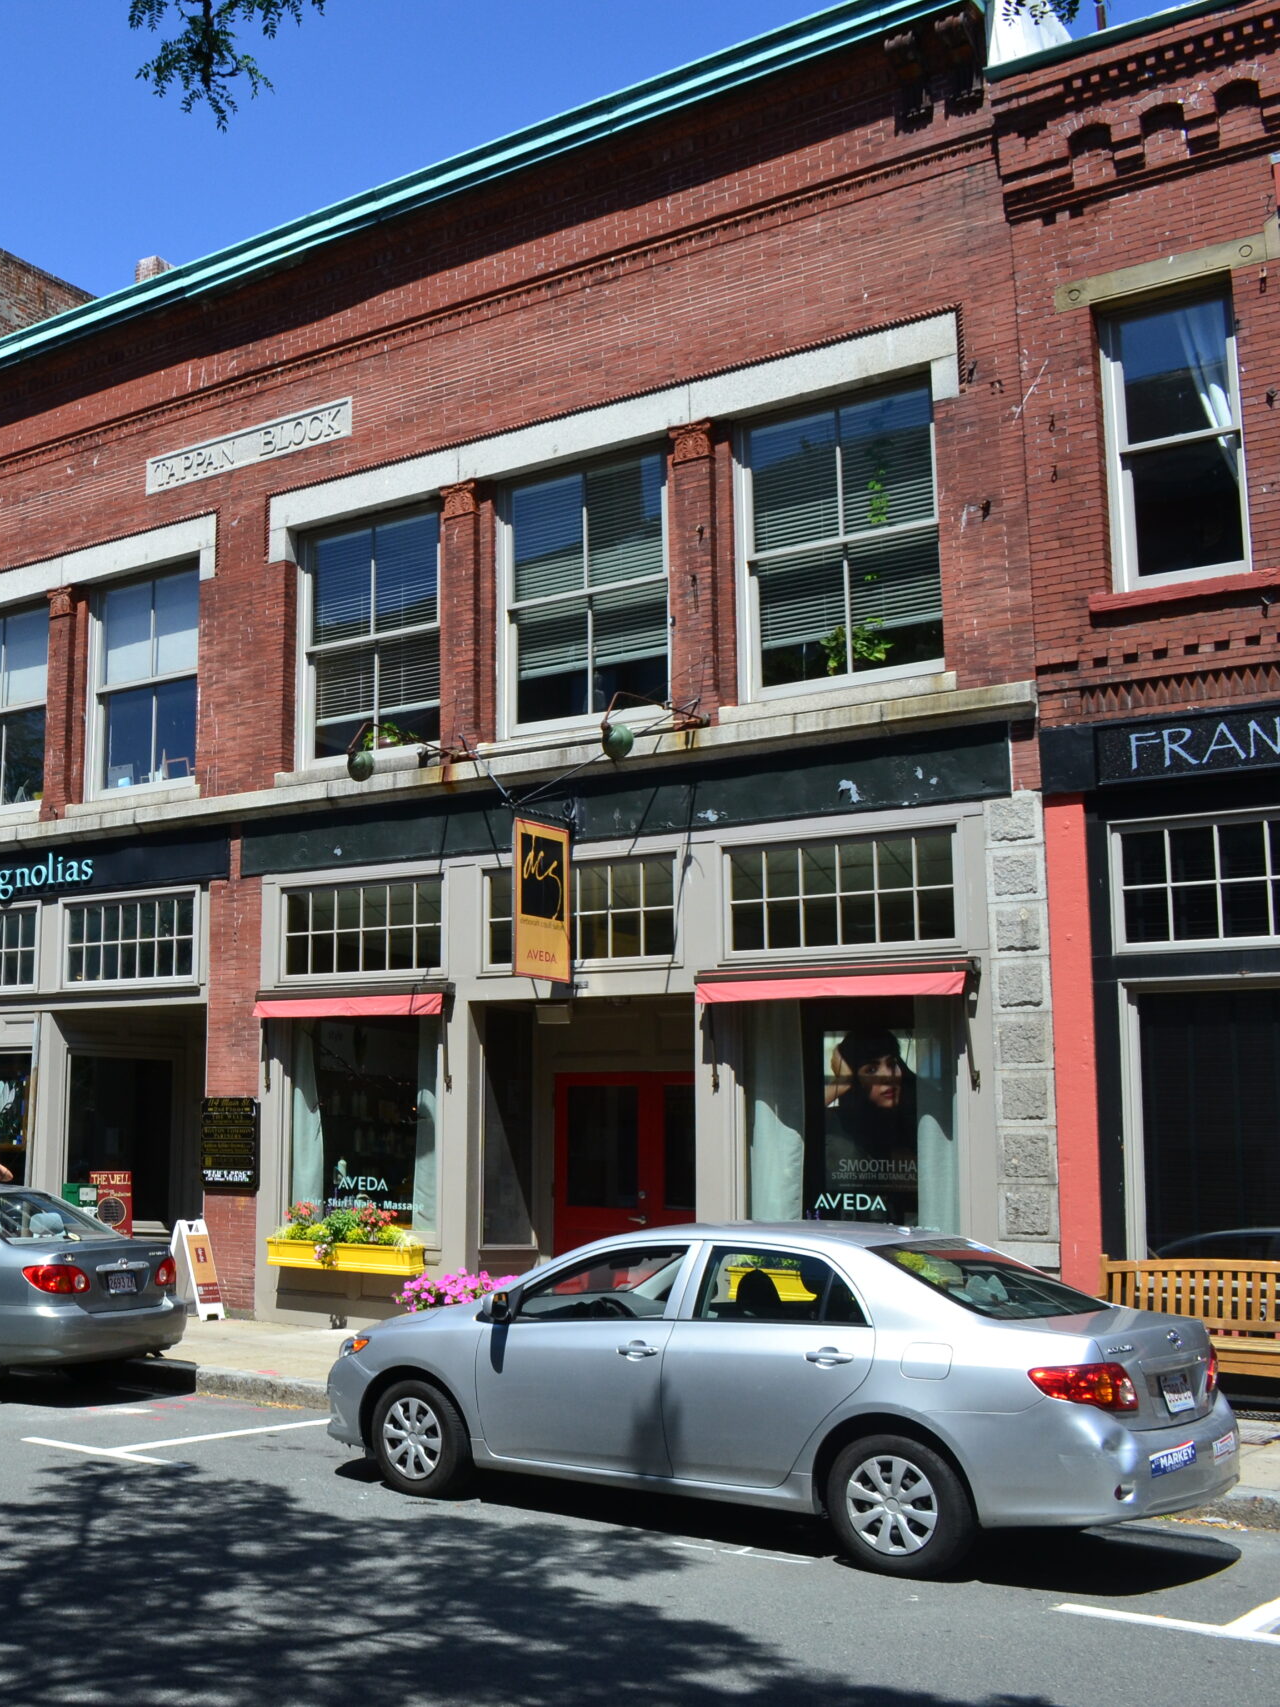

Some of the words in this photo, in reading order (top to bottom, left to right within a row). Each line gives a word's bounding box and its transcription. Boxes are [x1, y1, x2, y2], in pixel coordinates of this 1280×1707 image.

[153, 440, 236, 487] TAPPAN
[259, 408, 342, 457] BLOCK
[1129, 716, 1280, 770] FRAN
[526, 949, 557, 963] AVEDA
[839, 1159, 895, 1172] SMOOTH
[90, 1174, 108, 1185] THE
[108, 1174, 131, 1185] WELL
[338, 1176, 389, 1191] AVEDA
[832, 1172, 857, 1181] STARTS
[859, 1172, 876, 1181] WITH
[383, 1201, 424, 1212] Massage
[814, 1192, 887, 1211] AVEDA
[1160, 1447, 1193, 1468] MARKEY
